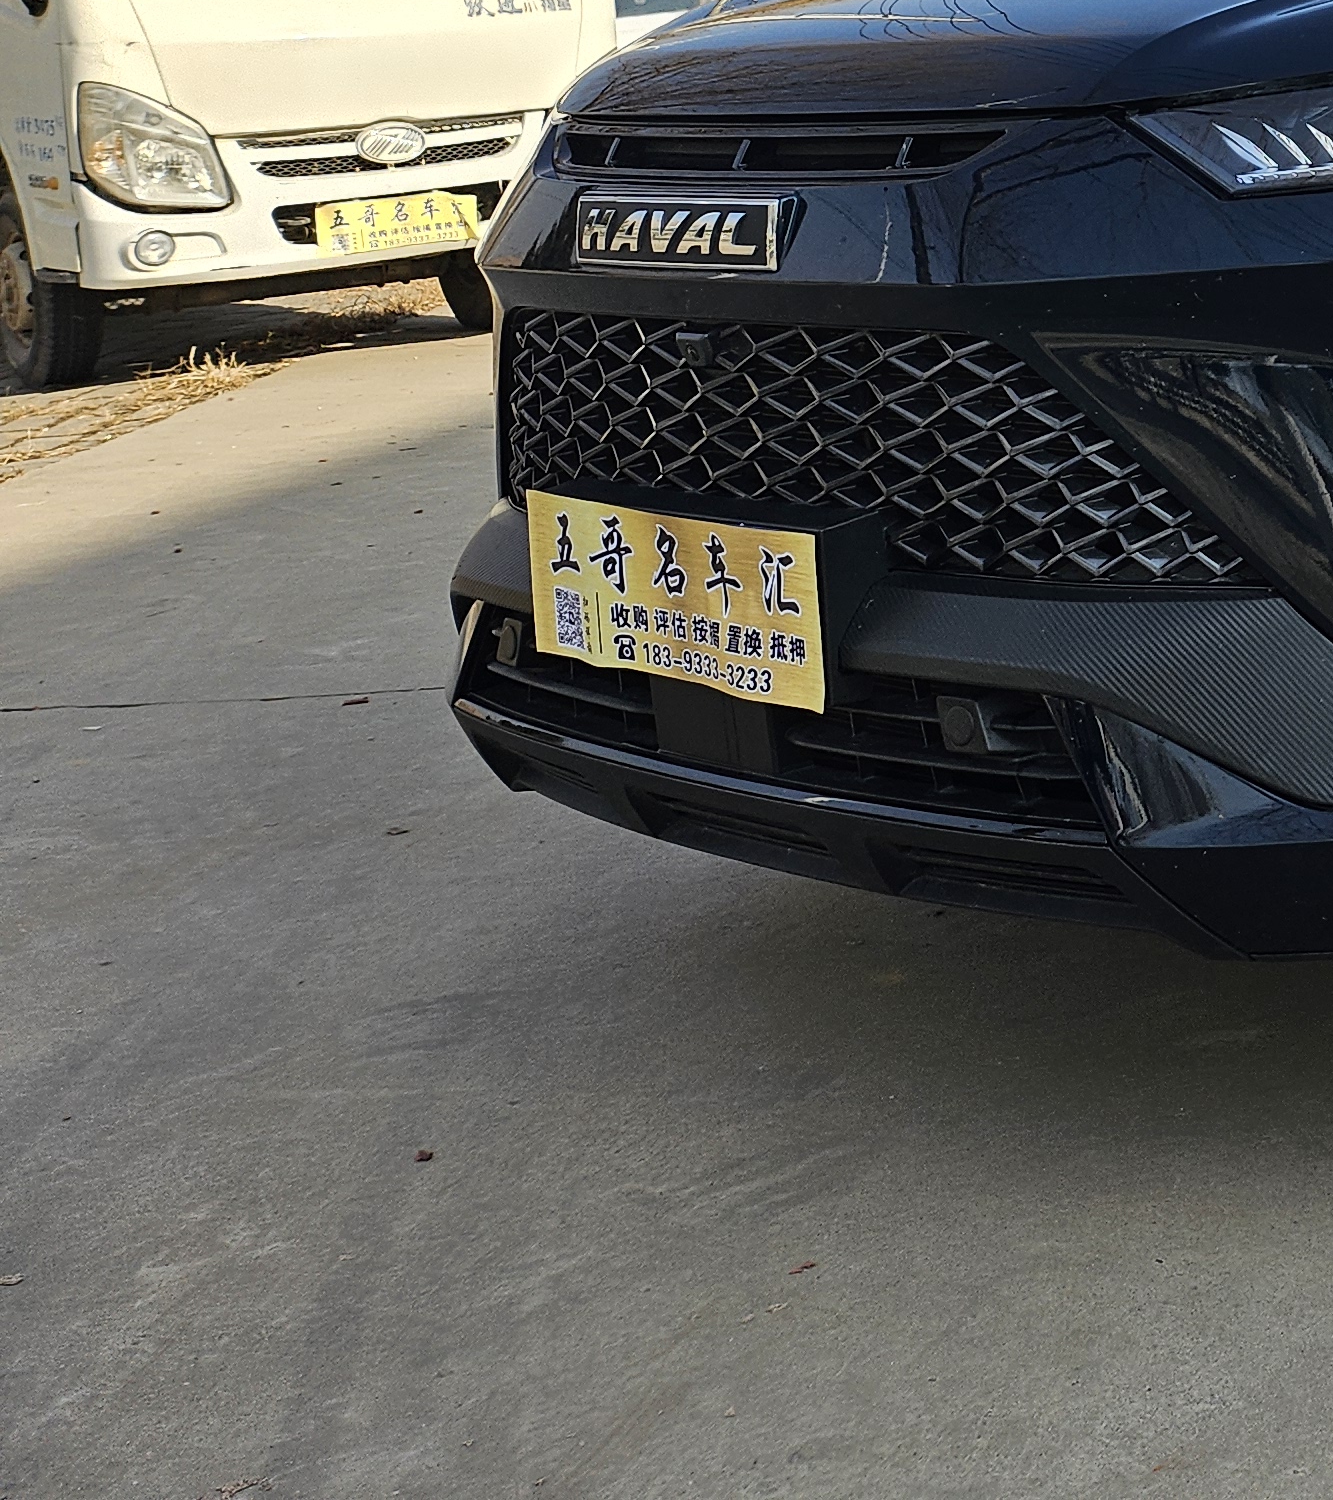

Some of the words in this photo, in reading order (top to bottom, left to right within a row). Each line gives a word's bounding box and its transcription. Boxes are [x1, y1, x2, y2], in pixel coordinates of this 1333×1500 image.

[581, 208, 758, 256] HAVAL
[551, 512, 802, 616] 五哥名车汇
[610, 603, 649, 633] 收购
[653, 608, 688, 642] 评估
[692, 615, 721, 650] 按揭
[725, 625, 764, 659] 置换
[768, 631, 807, 667] 抵押
[642, 642, 773, 694] 183-9333-3233
